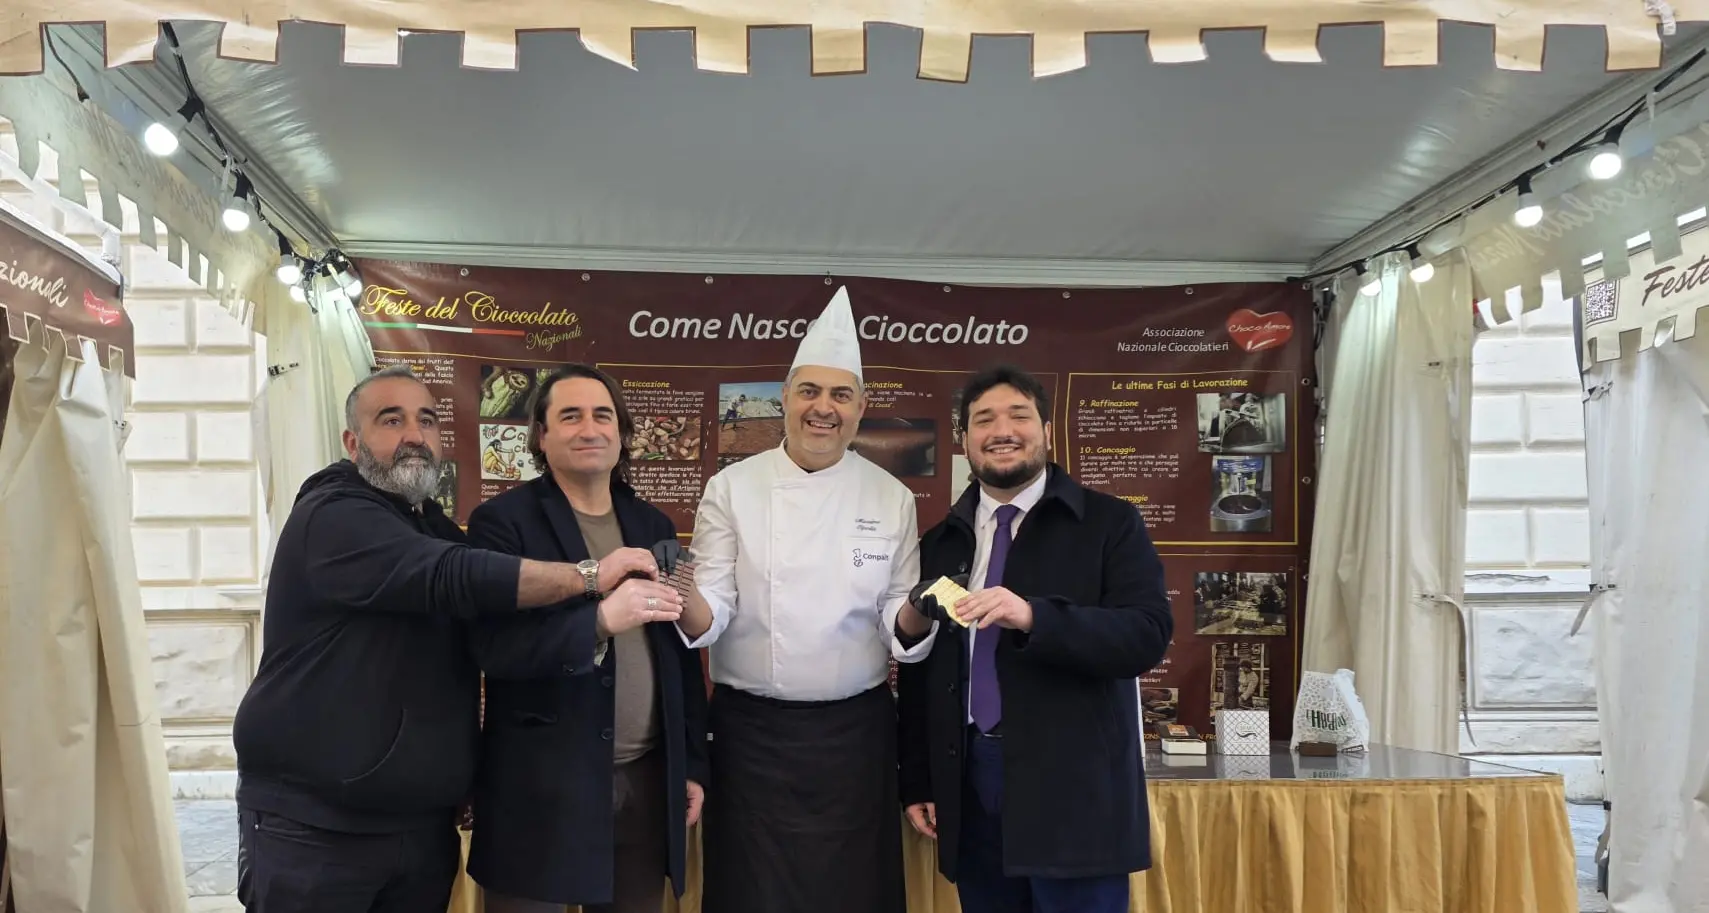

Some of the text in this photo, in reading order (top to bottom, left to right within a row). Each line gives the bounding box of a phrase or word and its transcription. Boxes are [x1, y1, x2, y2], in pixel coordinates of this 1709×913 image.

[360, 284, 579, 327] Feste del Cioccolato
[628, 310, 721, 340] Come
[859, 314, 1029, 345] Cioccolato
[1143, 327, 1205, 337] Associazione
[526, 325, 583, 351] Nazionali
[1117, 342, 1229, 352] Nazionale Cioccolatieri
[622, 379, 671, 388] Essiccazione
[1111, 377, 1249, 390] Le ultime Fasi di Lavorazione
[1080, 446, 1136, 454] 10. Concaggio
